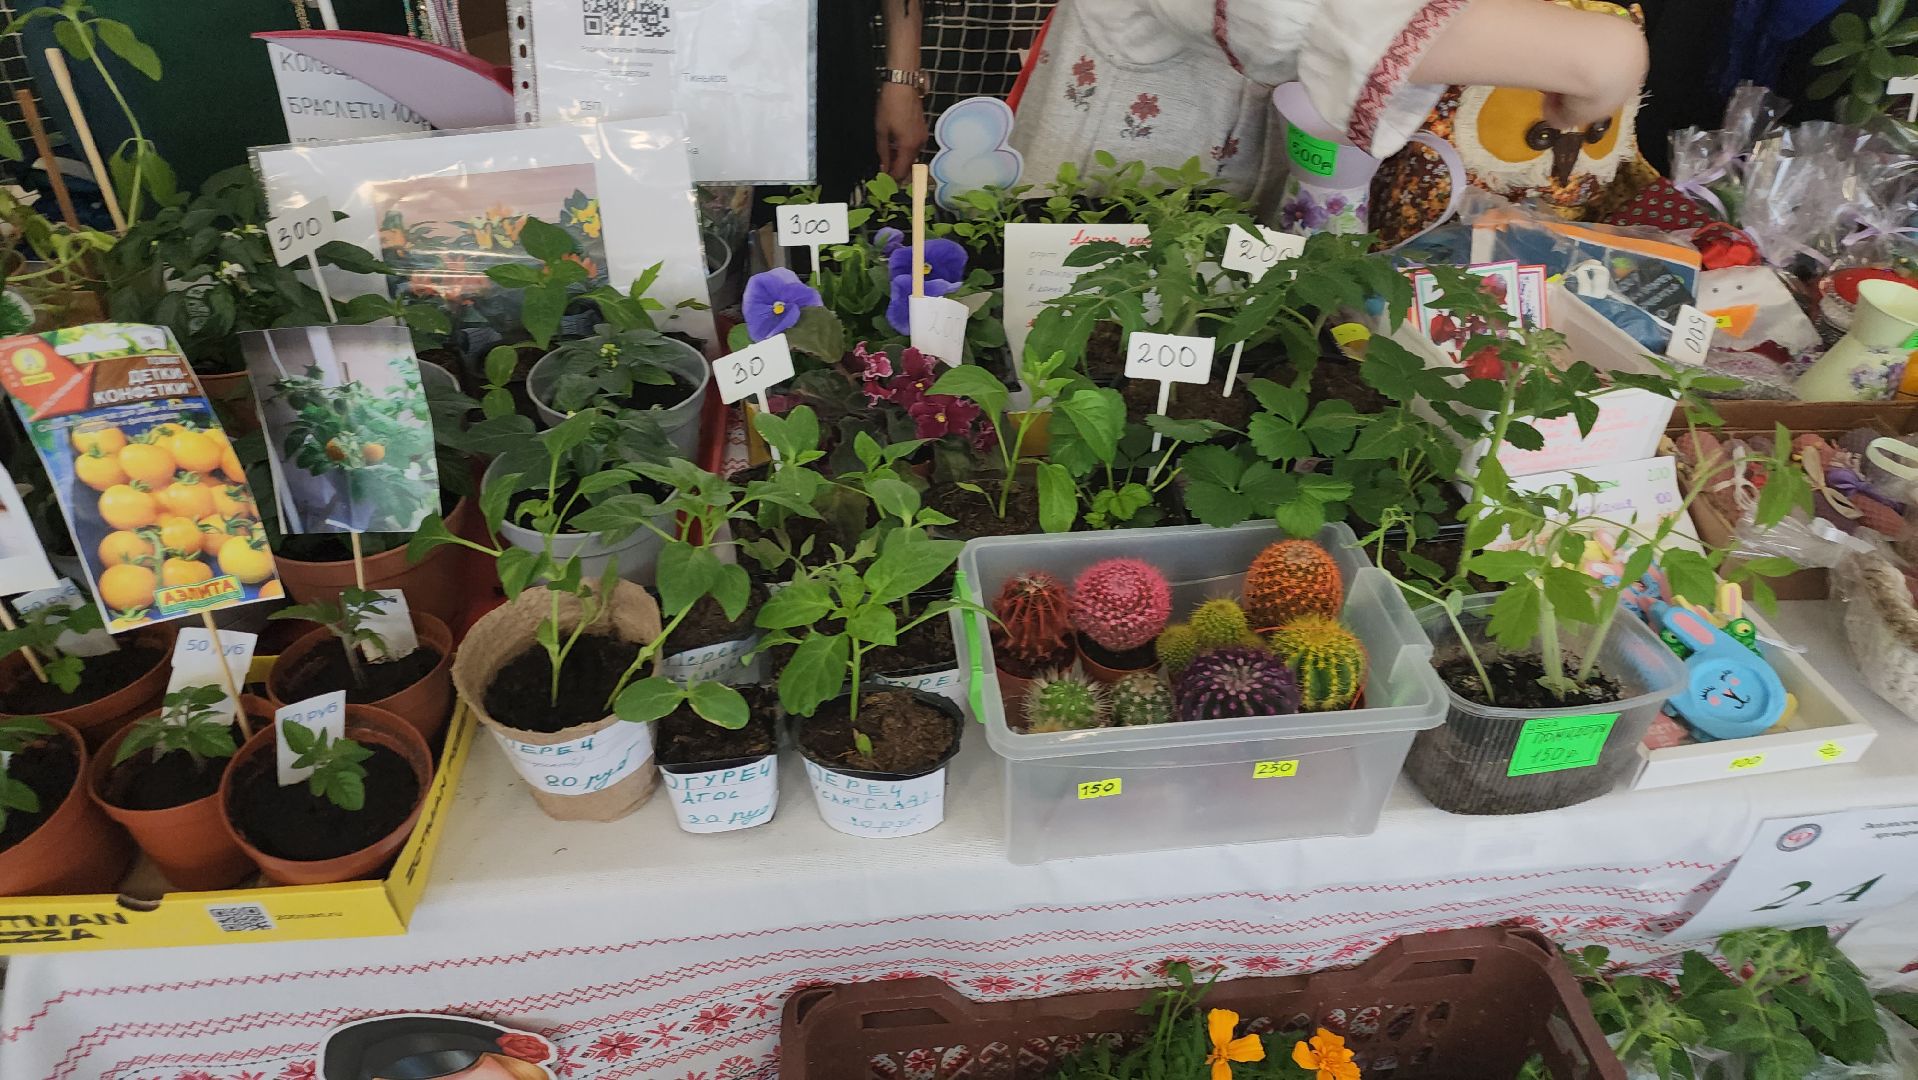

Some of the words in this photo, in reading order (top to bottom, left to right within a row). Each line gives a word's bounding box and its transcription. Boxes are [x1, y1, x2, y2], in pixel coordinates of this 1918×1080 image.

[287, 96, 386, 121] БРАСЛЕТЫ
[277, 216, 322, 251] 300
[789, 213, 831, 235] 300
[1684, 315, 1707, 354] 500
[1137, 342, 1198, 368] 200
[731, 355, 765, 385] 30
[163, 580, 237, 606] АЭЛИТА
[186, 638, 210, 652] 50
[1256, 762, 1293, 775] 250
[1080, 782, 1115, 797] 150
